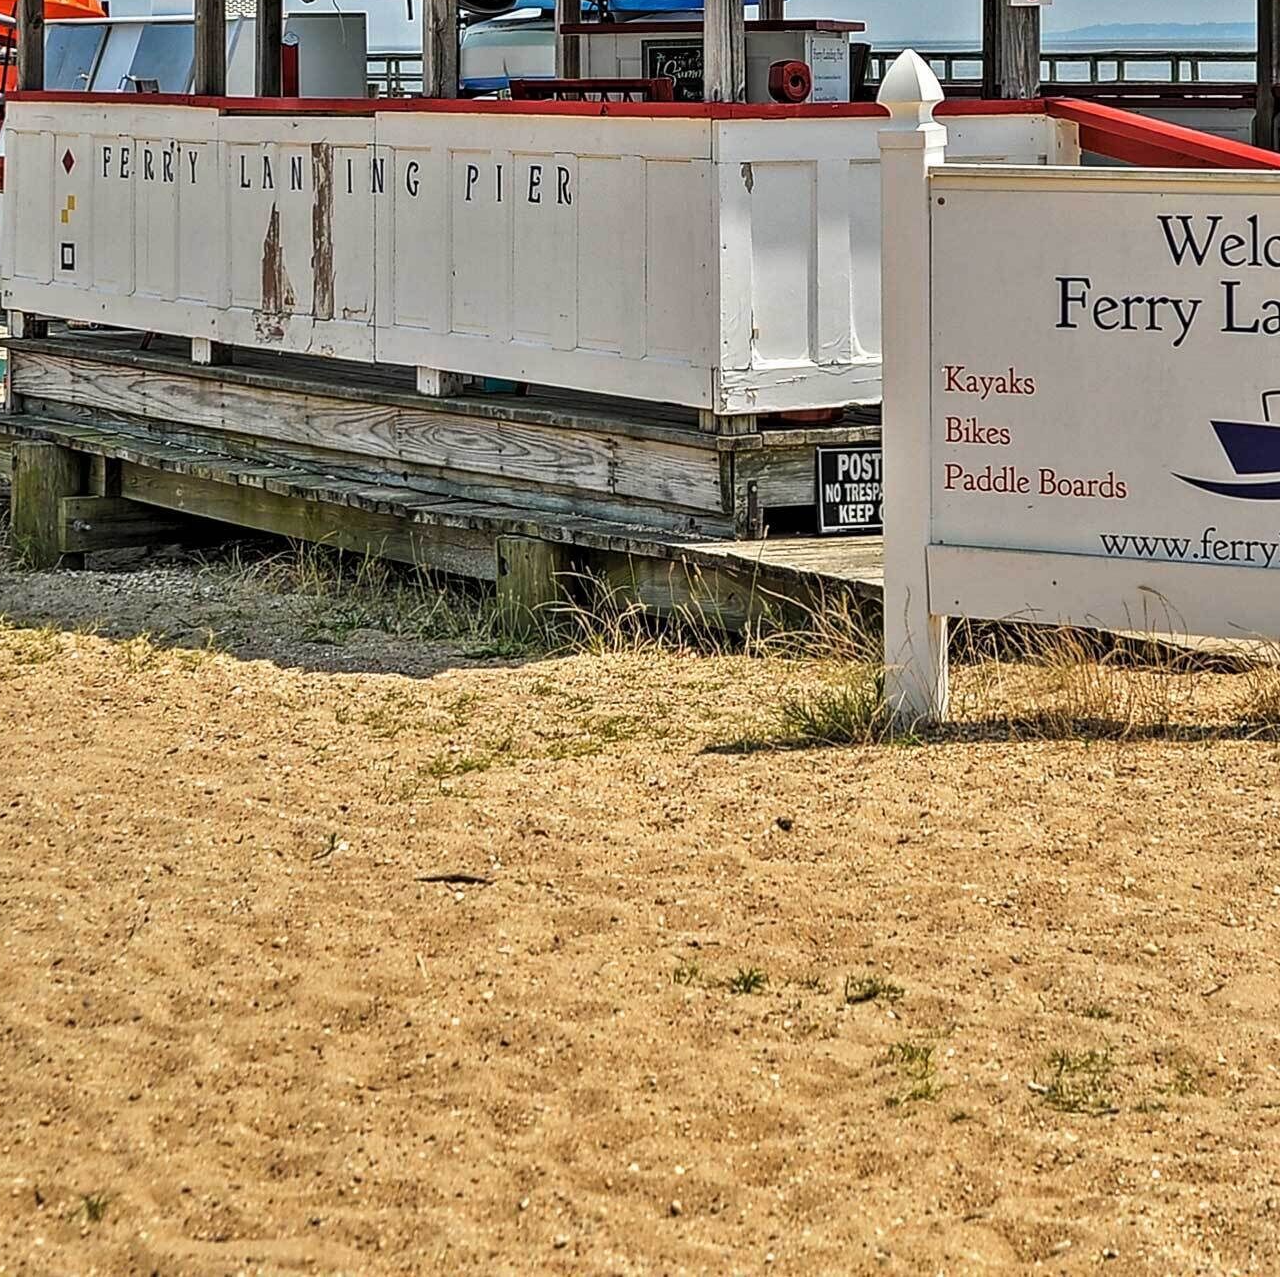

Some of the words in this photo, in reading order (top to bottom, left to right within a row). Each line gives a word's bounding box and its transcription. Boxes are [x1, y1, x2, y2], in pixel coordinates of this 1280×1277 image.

[103, 146, 198, 184] FERRY
[240, 154, 420, 197] LANING
[465, 164, 572, 205] PIER
[1054, 276, 1202, 348] Ferry
[944, 365, 1036, 400] Kayaks
[945, 416, 1011, 445] Bikes
[837, 452, 882, 481] POST
[943, 463, 1031, 494] Paddle
[1038, 468, 1128, 499] Boards
[825, 482, 842, 503] NO
[838, 503, 875, 524] KEEP
